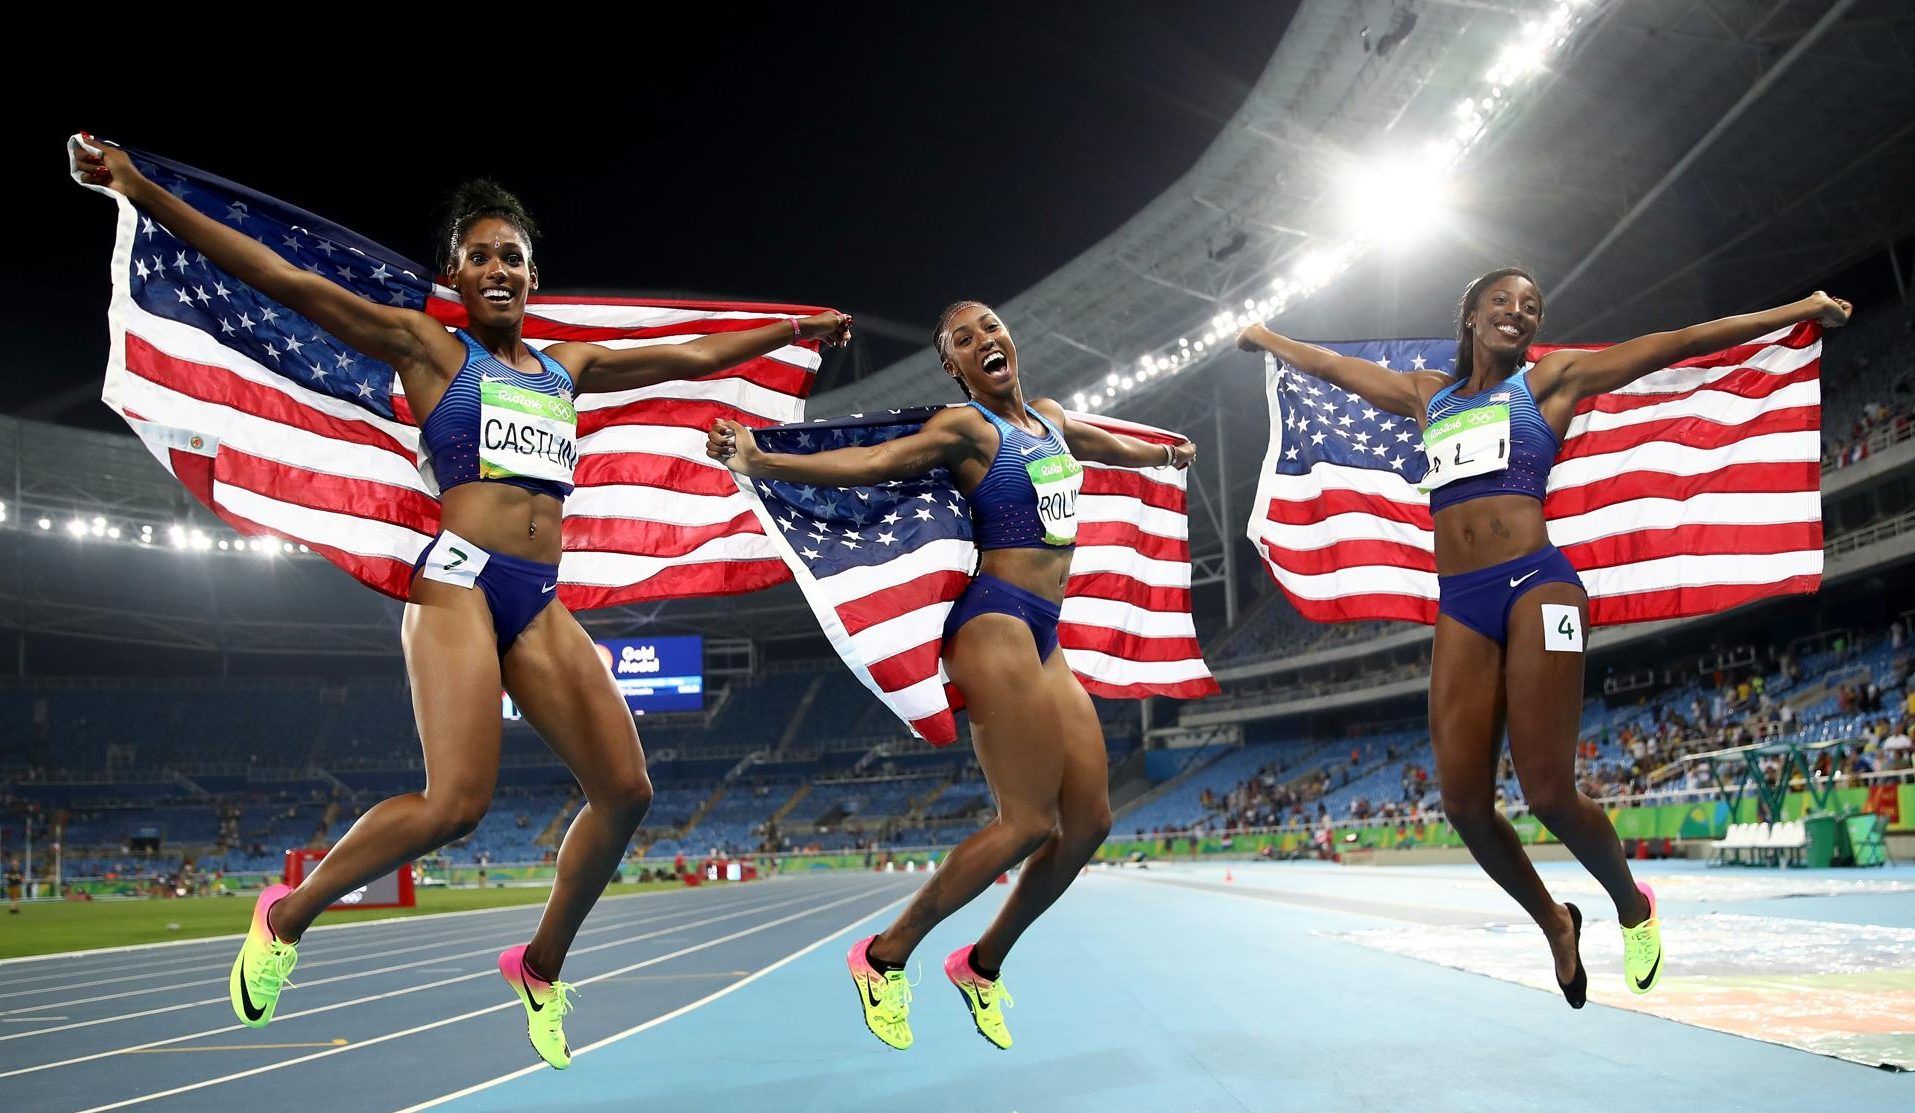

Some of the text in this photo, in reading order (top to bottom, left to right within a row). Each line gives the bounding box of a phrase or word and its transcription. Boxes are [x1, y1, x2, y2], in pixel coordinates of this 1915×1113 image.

[443, 546, 469, 571] 7
[1558, 614, 1575, 641] 4
[621, 645, 655, 661] Gold
[617, 657, 660, 674] Medal
